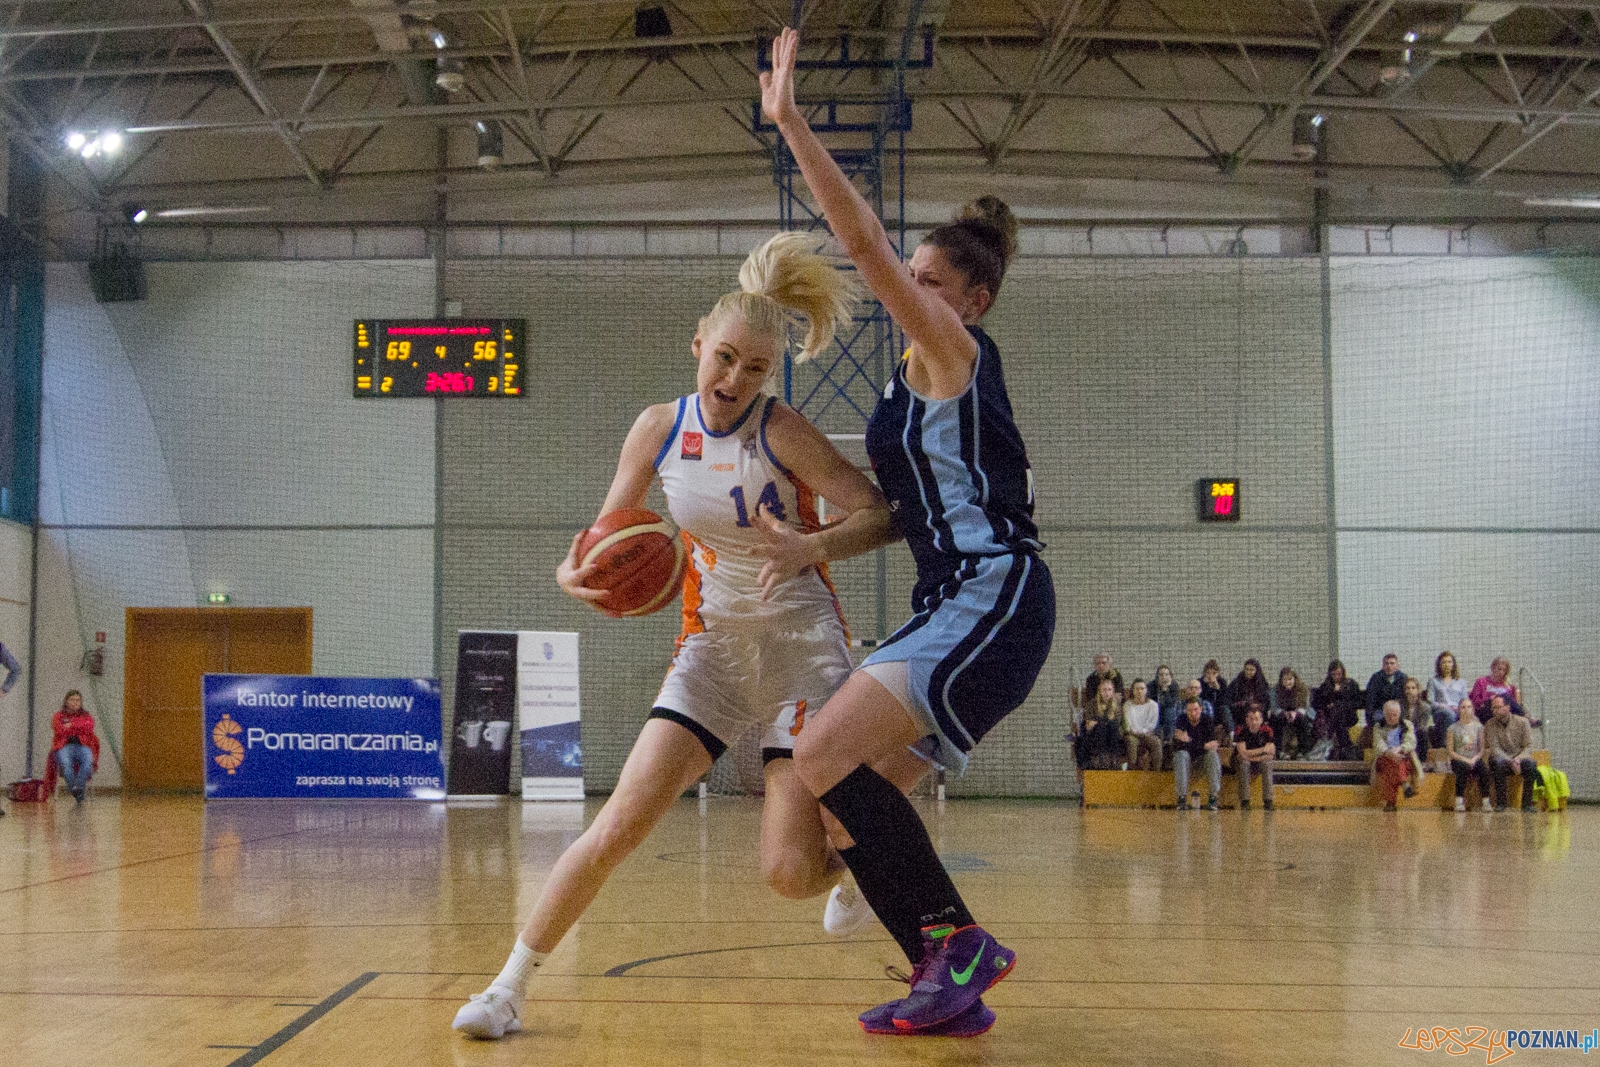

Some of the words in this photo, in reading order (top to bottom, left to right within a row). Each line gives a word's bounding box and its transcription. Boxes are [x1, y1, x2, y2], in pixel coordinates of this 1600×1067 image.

[386, 341, 412, 361] 69
[434, 345, 447, 359] 4
[473, 341, 497, 361] 56
[381, 376, 394, 392] 2
[487, 376, 499, 392] 3
[729, 481, 787, 528] 14
[1214, 496, 1233, 514] 10
[237, 688, 298, 707] kantor
[302, 690, 414, 711] internetowy
[296, 775, 346, 787] zaprasza
[348, 776, 363, 785] na
[366, 774, 400, 787] swoją
[402, 775, 440, 788] stronę
